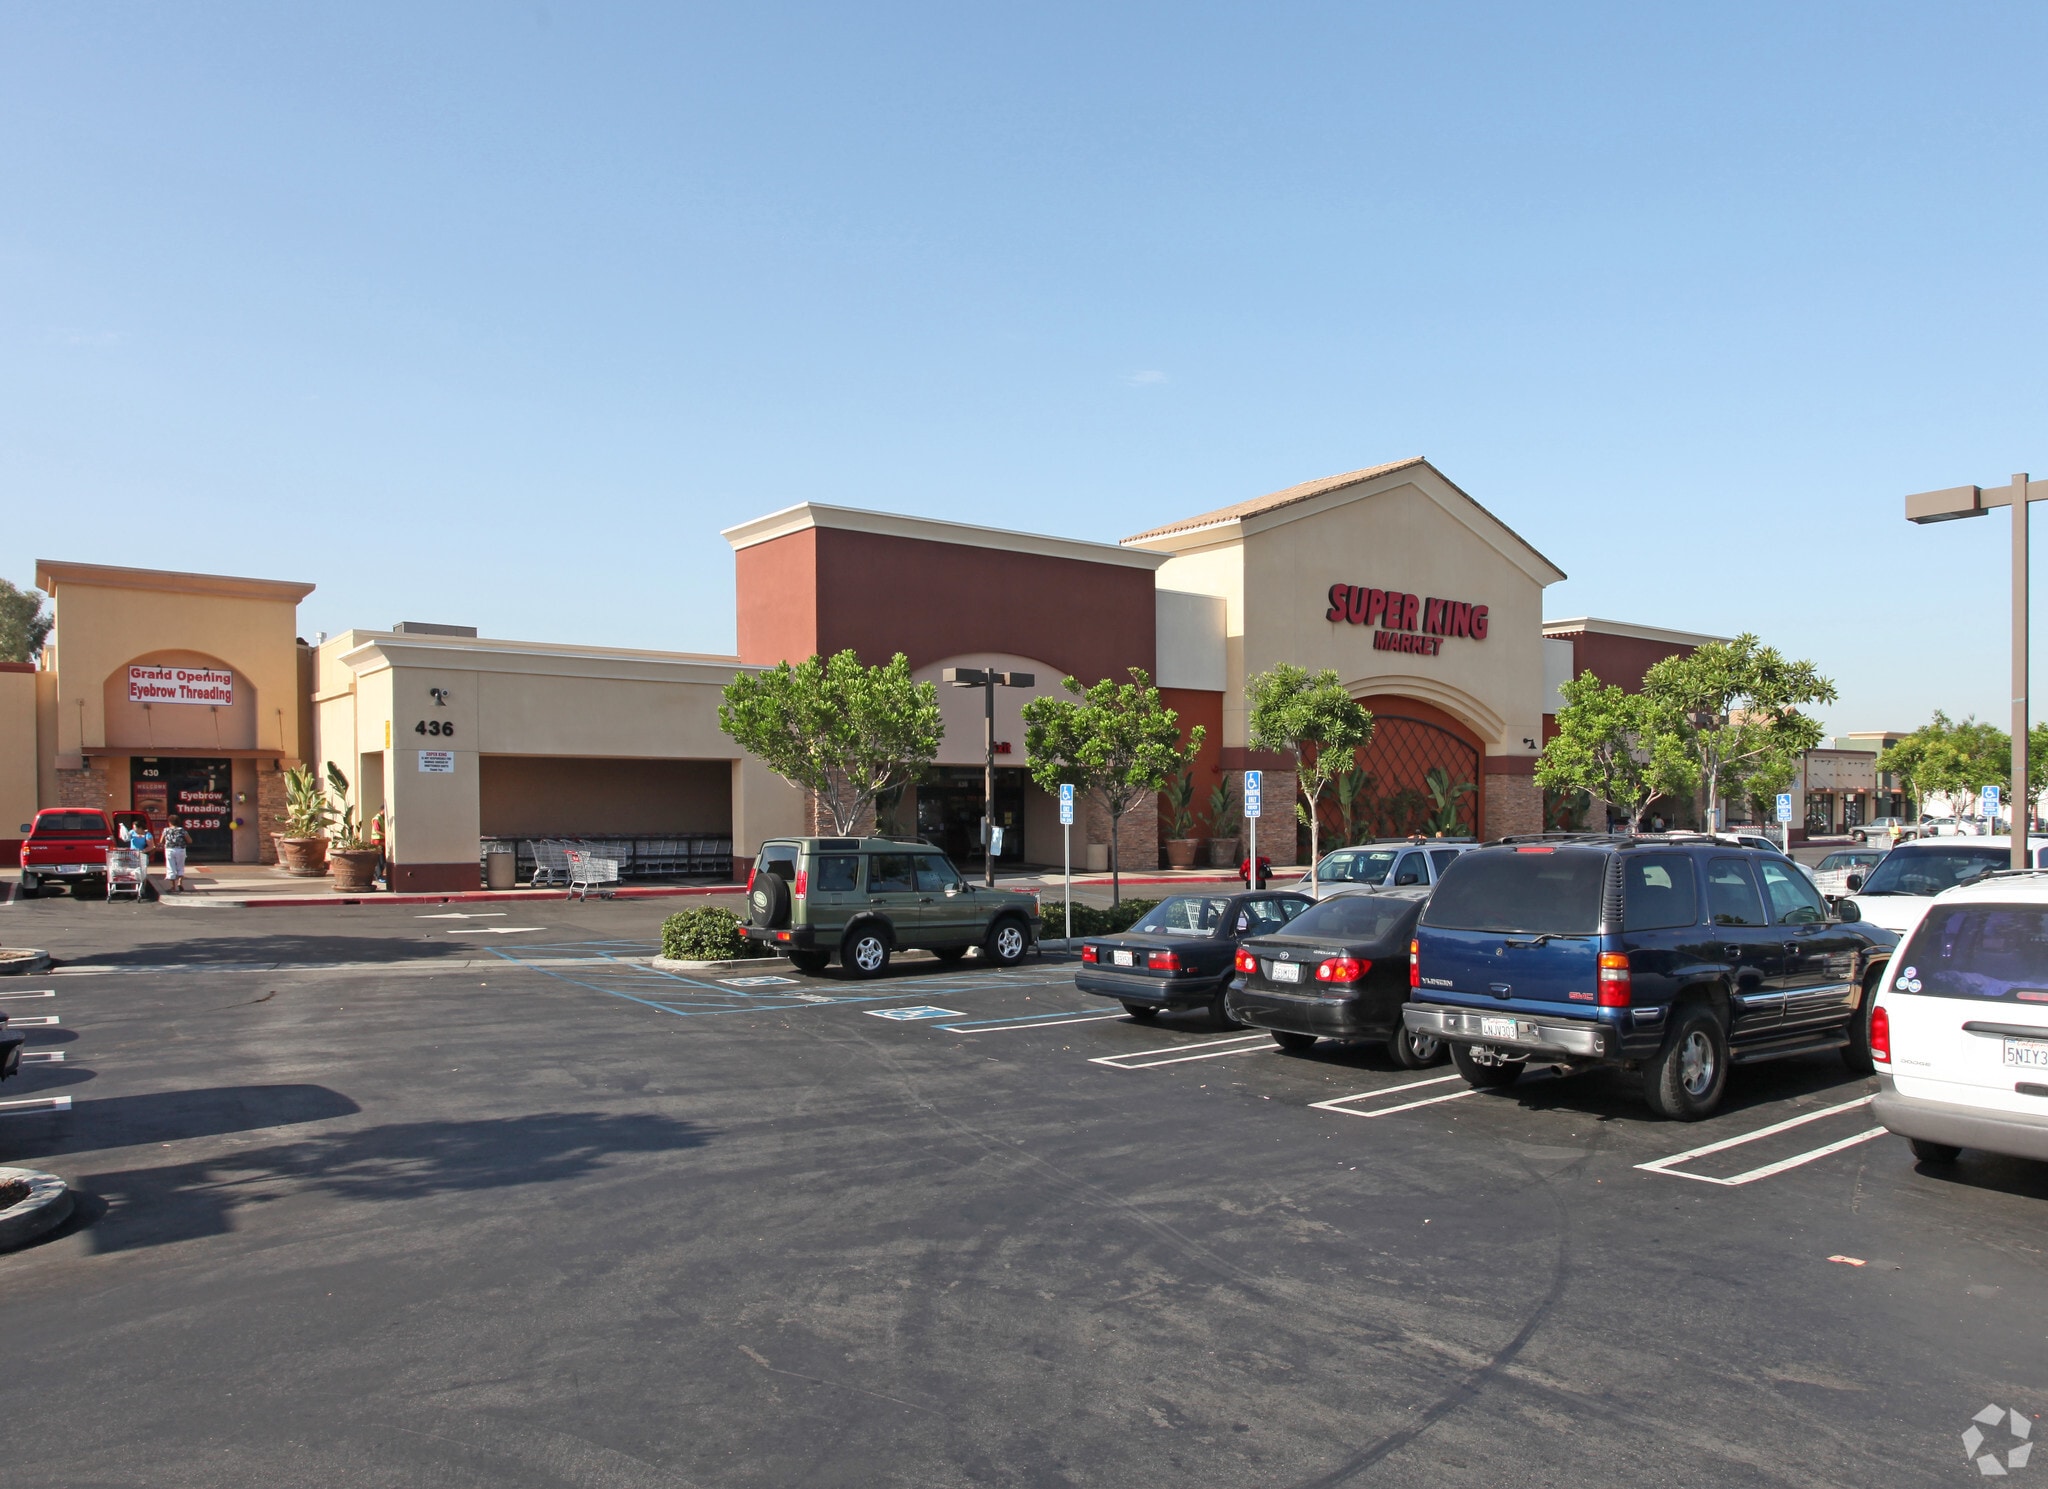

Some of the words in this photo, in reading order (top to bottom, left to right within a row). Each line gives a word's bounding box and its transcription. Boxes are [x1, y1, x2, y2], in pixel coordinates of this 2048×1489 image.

[1326, 583, 1419, 631] SUPER
[1422, 596, 1489, 640] KING
[1373, 630, 1444, 656] MARKET
[130, 667, 172, 680] Grand
[176, 670, 231, 685] Opening
[130, 682, 176, 699] Eyebrow
[179, 685, 232, 703] Threading
[415, 720, 454, 737] 436
[142, 769, 159, 777] 430
[180, 791, 222, 801] Eyebrow
[176, 804, 227, 814] Threading
[184, 819, 221, 829] $5.99
[1421, 977, 1453, 987] YUKON
[1568, 991, 1594, 1000] GMC
[2007, 1047, 2048, 1065] 5NIY3
[1900, 1058, 1932, 1067] DODGE
